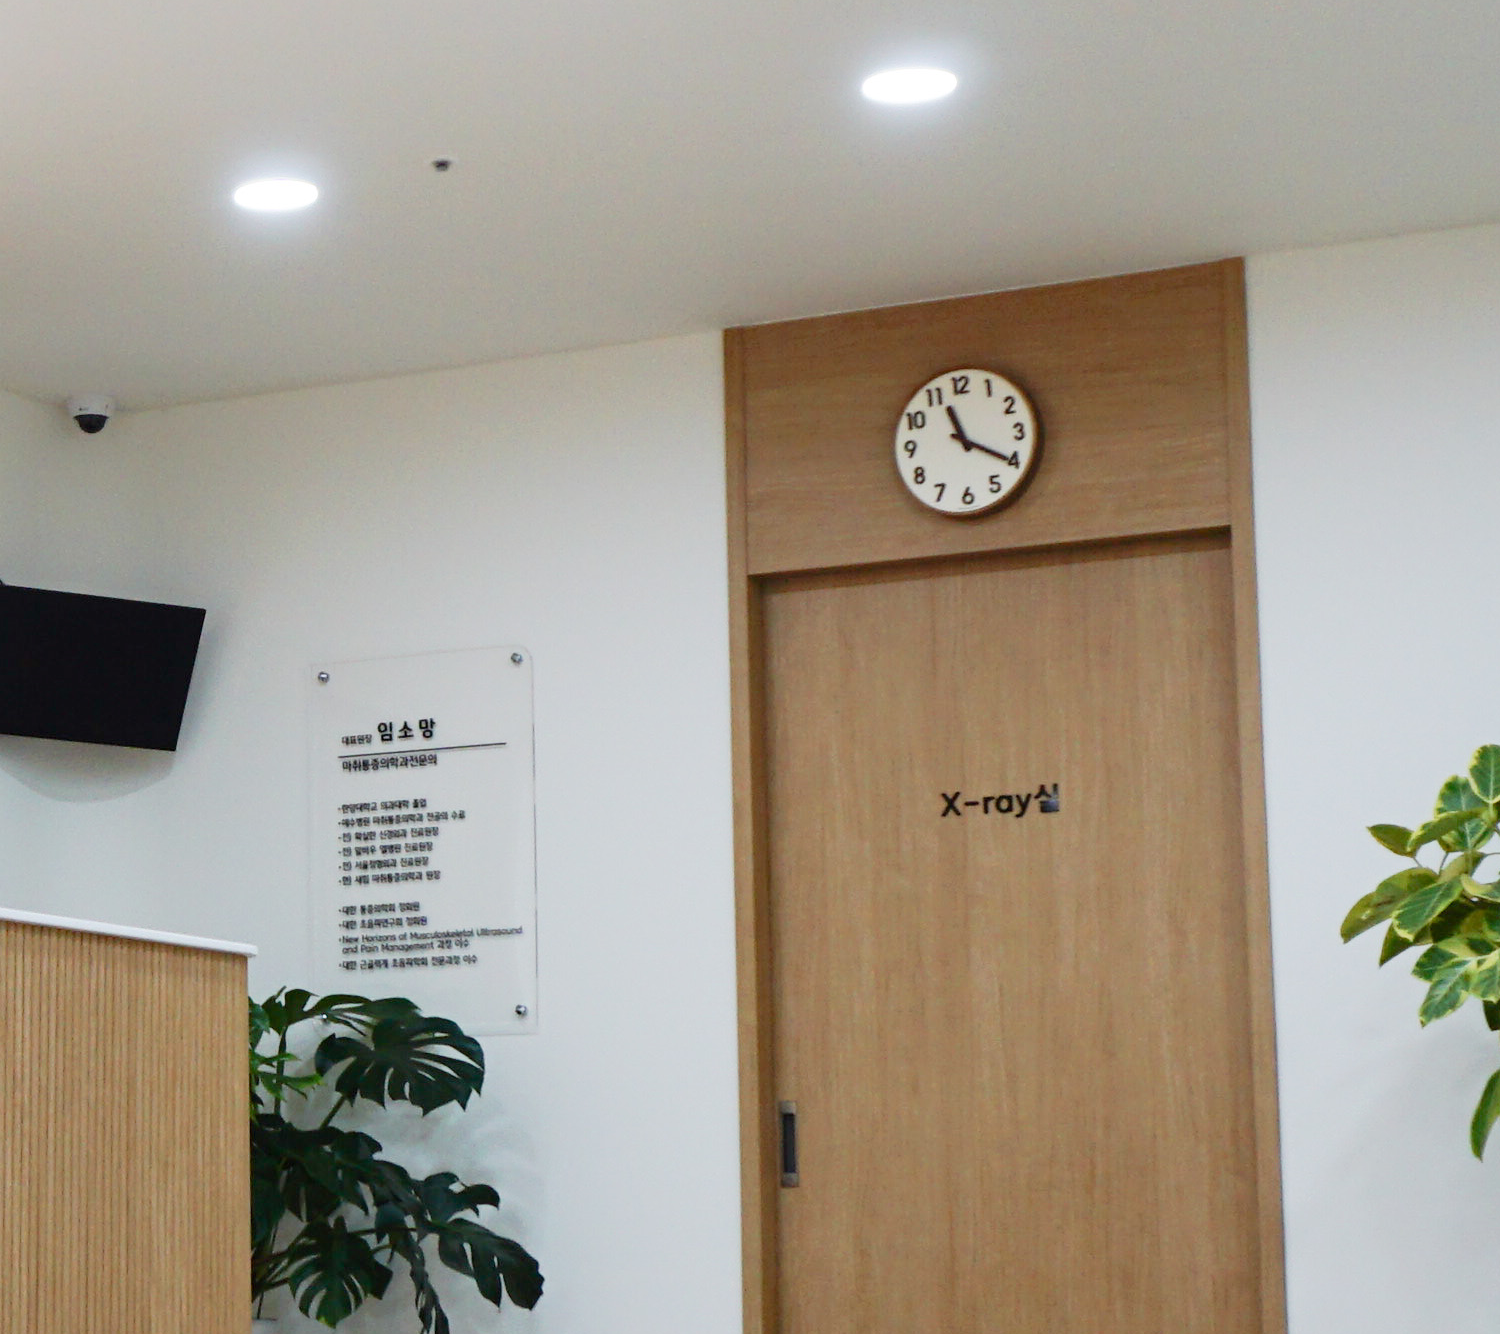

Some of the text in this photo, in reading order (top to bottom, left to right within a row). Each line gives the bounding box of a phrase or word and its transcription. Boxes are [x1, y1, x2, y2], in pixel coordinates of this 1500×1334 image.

[951, 375, 970, 396] 12
[984, 379, 993, 397] 1
[925, 387, 943, 407] 11
[1003, 396, 1016, 415] 2
[906, 410, 926, 430] 10
[1013, 422, 1025, 441] 3
[904, 440, 917, 458] 9
[1008, 451, 1020, 469] 4
[914, 466, 926, 485] 8
[988, 474, 1002, 494] 5
[934, 483, 947, 502] 7
[961, 486, 975, 505] 6
[341, 733, 372, 746] 대표원장
[940, 782, 1060, 818] X-ray실
